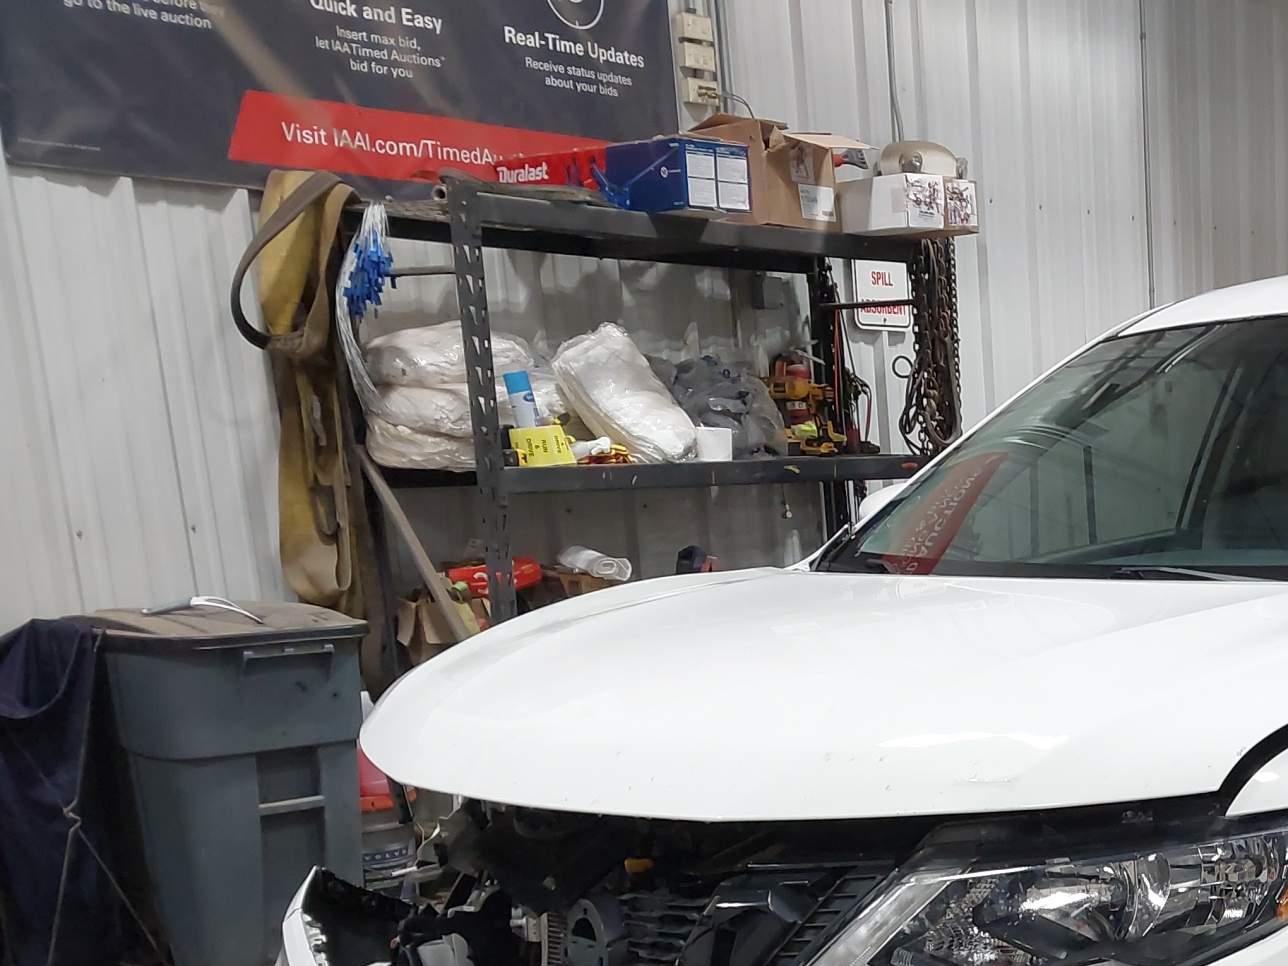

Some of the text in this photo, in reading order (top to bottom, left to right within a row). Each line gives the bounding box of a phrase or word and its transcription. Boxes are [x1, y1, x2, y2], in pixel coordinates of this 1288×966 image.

[106, 0, 131, 14] the
[134, 3, 157, 20] live
[161, 11, 212, 29] auction
[309, 0, 442, 34] Quick and Easy
[315, 35, 330, 50] let
[335, 25, 421, 51] Insert max bid,
[503, 25, 645, 68] Real-Time Updates
[349, 58, 414, 79] bid for you
[525, 56, 633, 86] Receive status updates
[545, 76, 619, 97] about your bids
[281, 121, 328, 147] Visit
[496, 161, 549, 184] Duralast
[871, 270, 894, 287] SPILL
